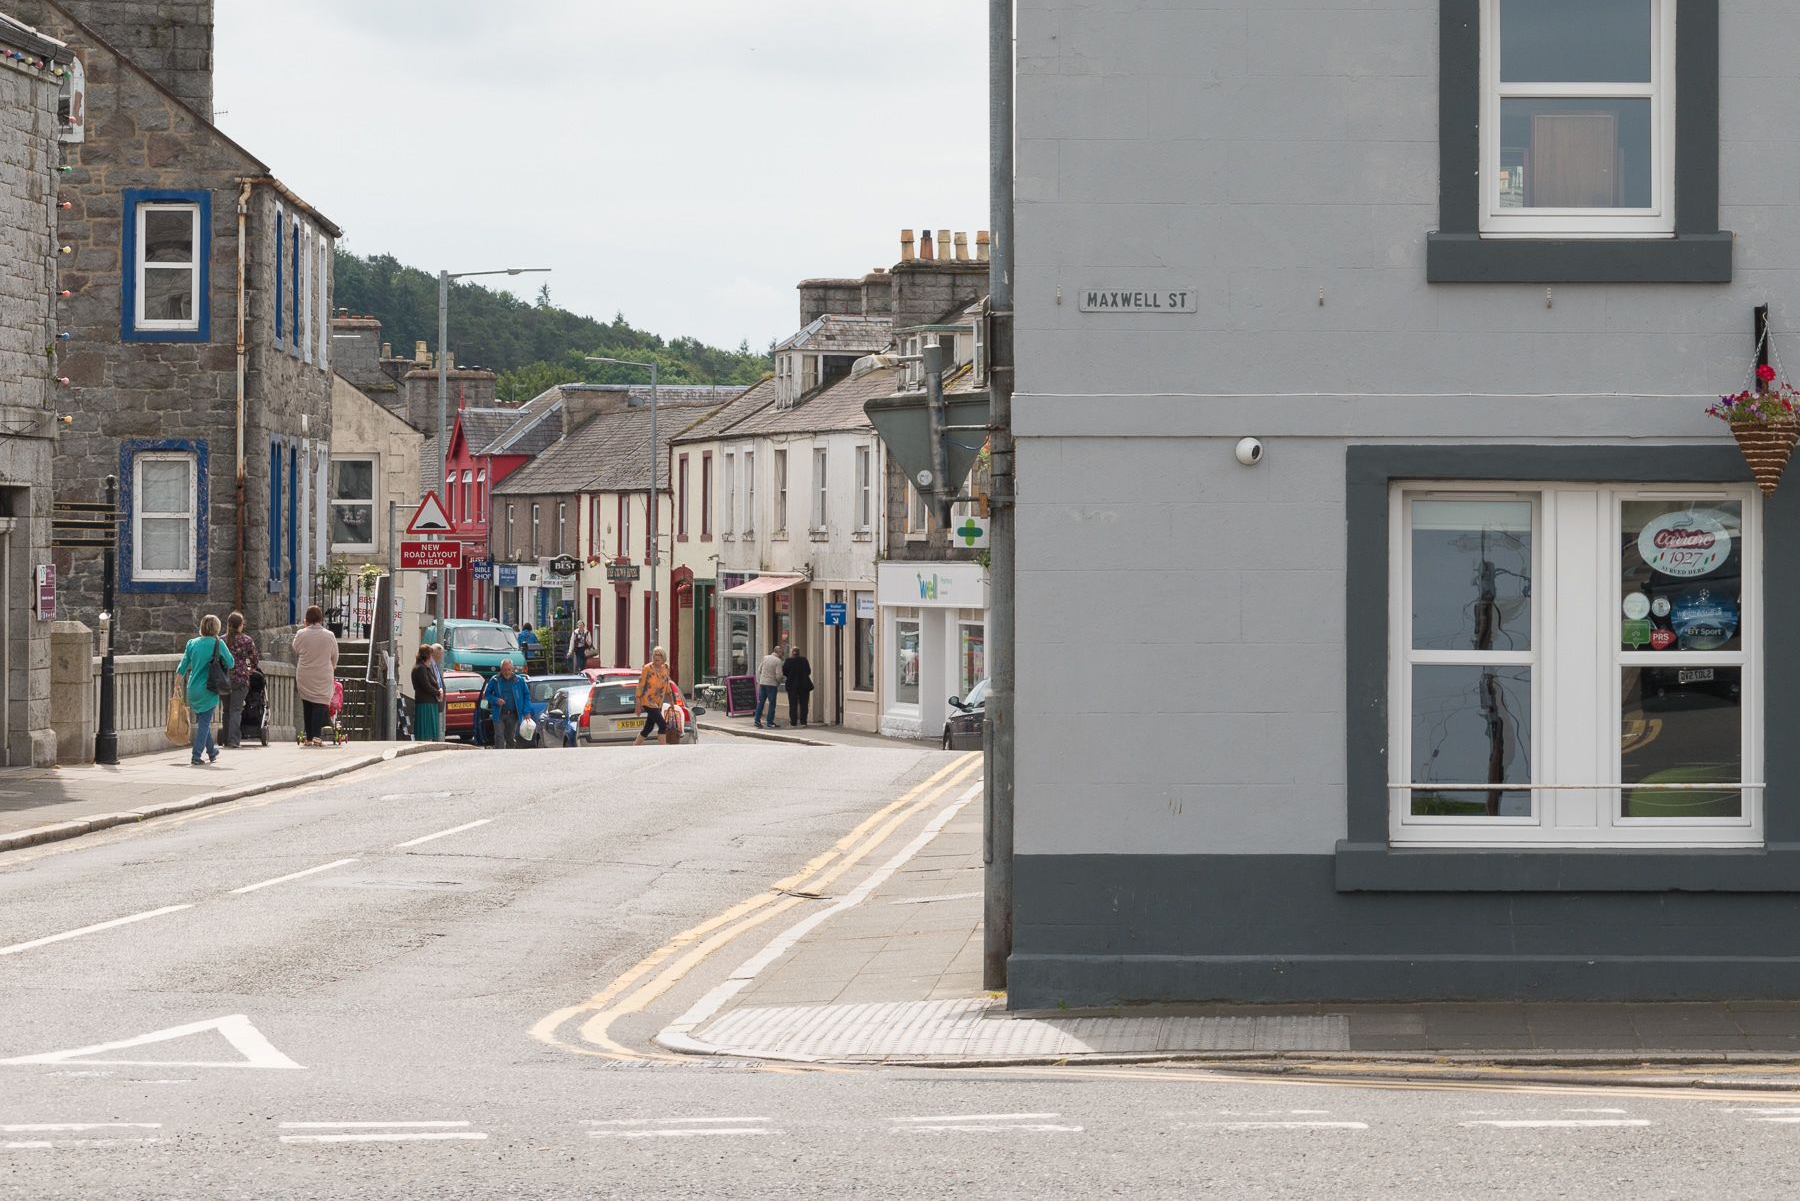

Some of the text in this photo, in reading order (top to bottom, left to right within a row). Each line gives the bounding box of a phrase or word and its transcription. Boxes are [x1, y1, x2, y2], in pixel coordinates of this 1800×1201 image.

[1087, 292, 1187, 308] MAXWELL ST
[1669, 550, 1704, 567] 1927
[1701, 628, 1722, 637] Sport
